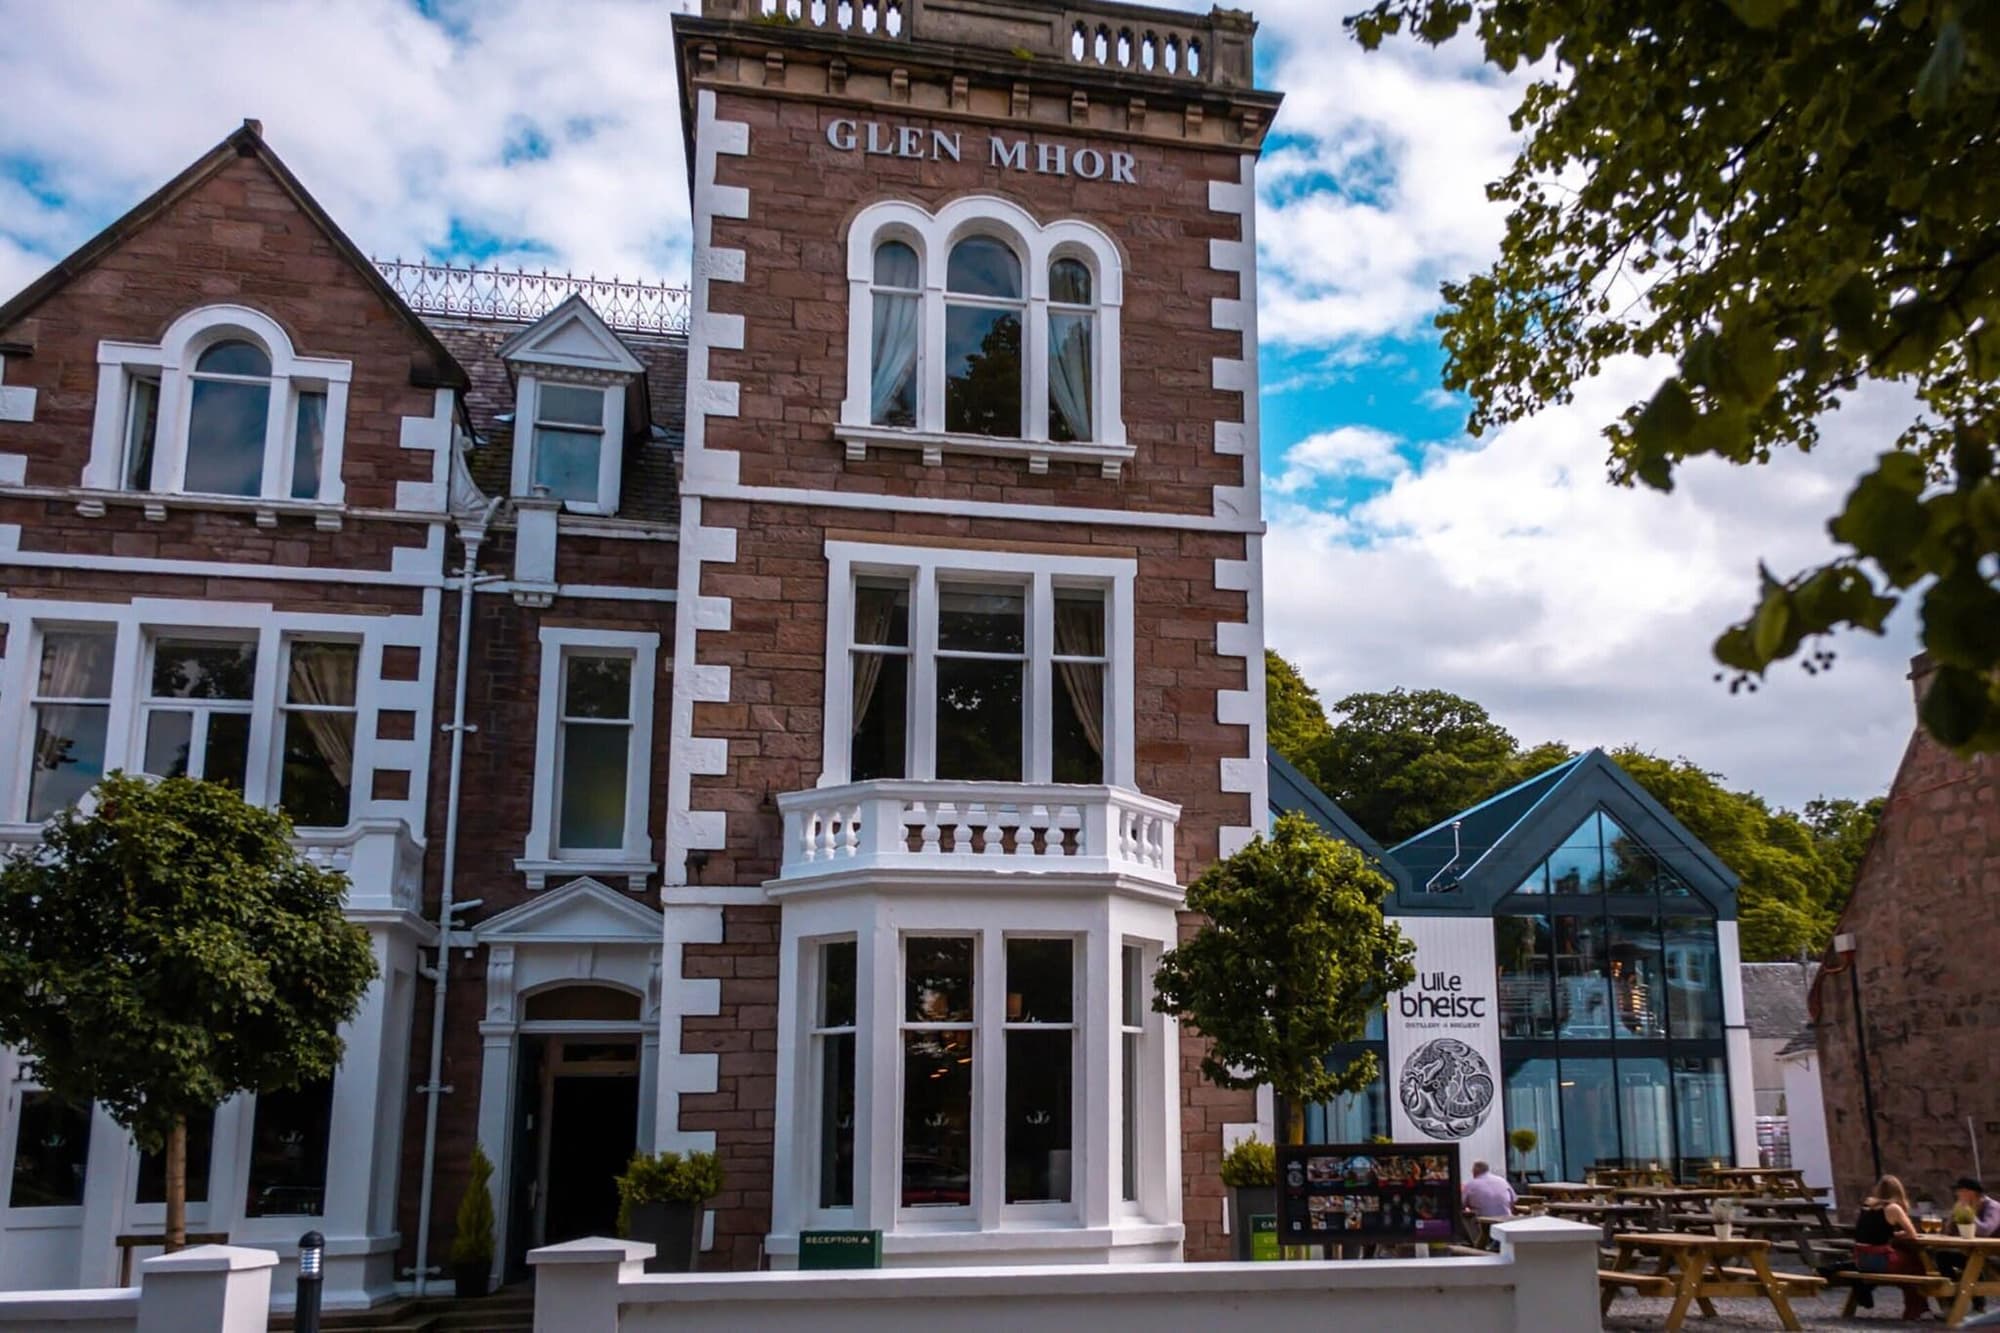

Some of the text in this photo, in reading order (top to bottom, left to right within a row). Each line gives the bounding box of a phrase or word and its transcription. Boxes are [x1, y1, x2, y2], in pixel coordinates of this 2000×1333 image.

[826, 119, 1136, 184] GLEN MHOR
[1400, 991, 1485, 1018] bheist
[804, 1236, 859, 1244] RECEPTION
